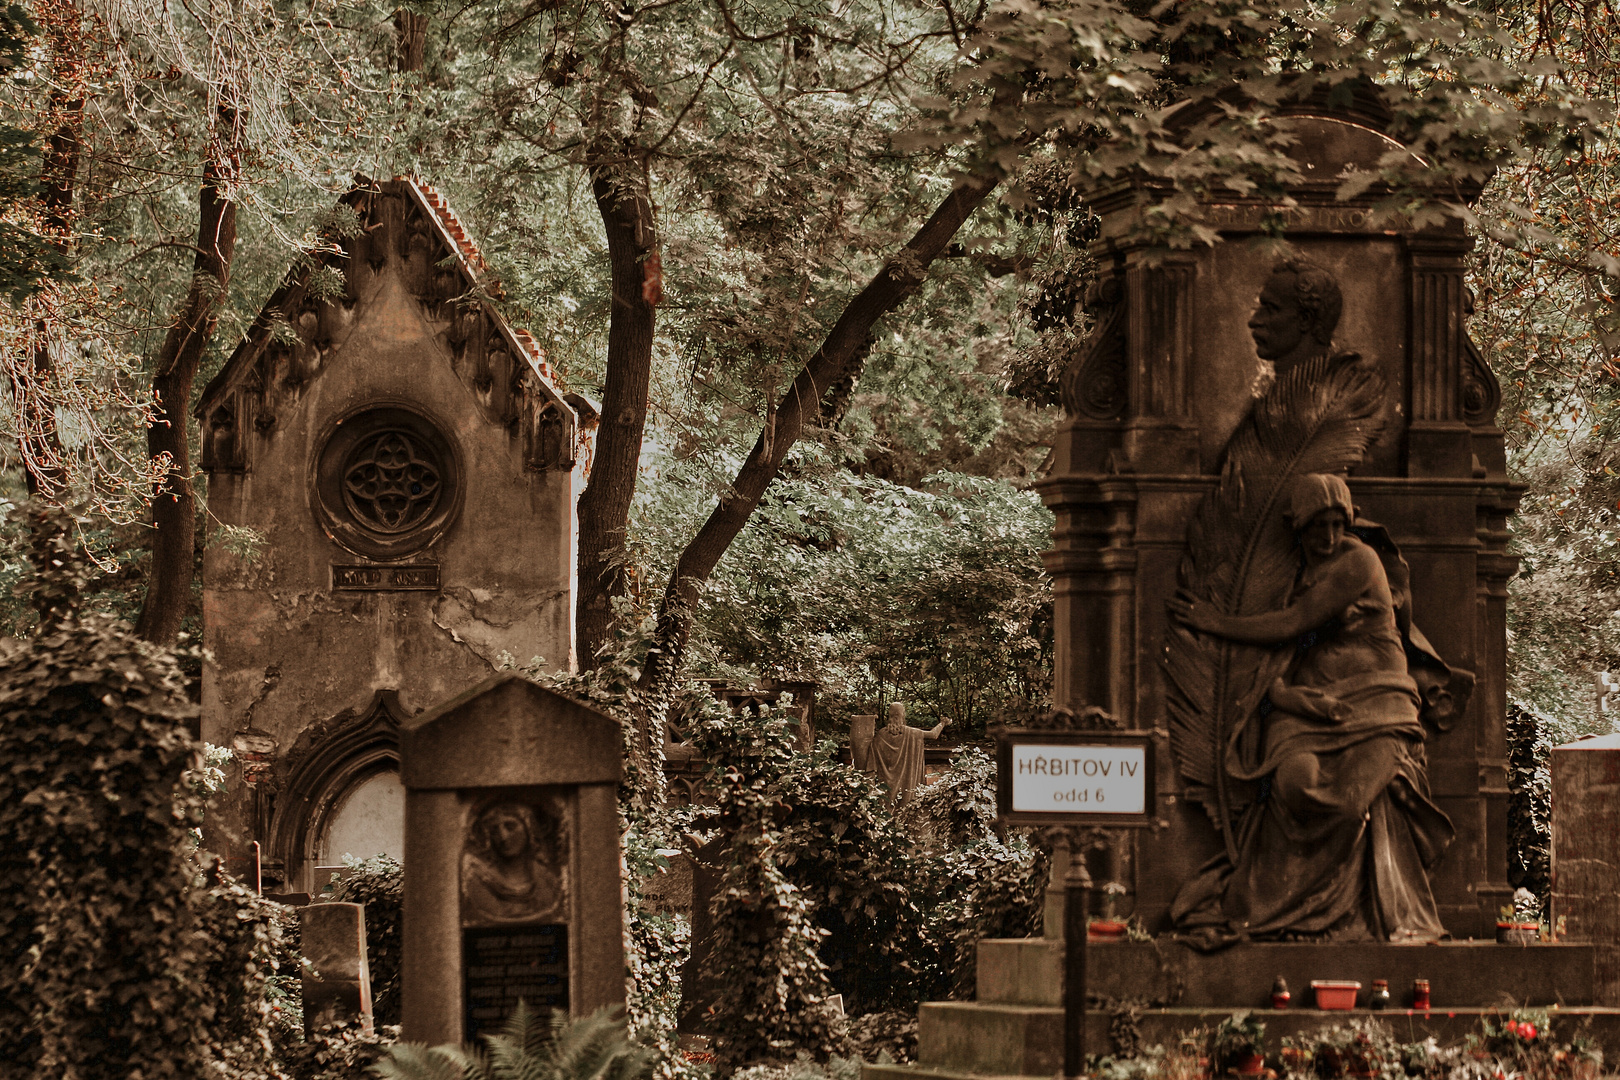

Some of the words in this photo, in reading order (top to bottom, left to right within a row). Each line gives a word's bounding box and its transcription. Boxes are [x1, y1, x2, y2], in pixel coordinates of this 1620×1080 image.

[1019, 754, 1112, 777] HŘBITOV
[1120, 761, 1138, 777] IV
[1053, 788, 1088, 802] odd
[1095, 788, 1105, 802] 6
